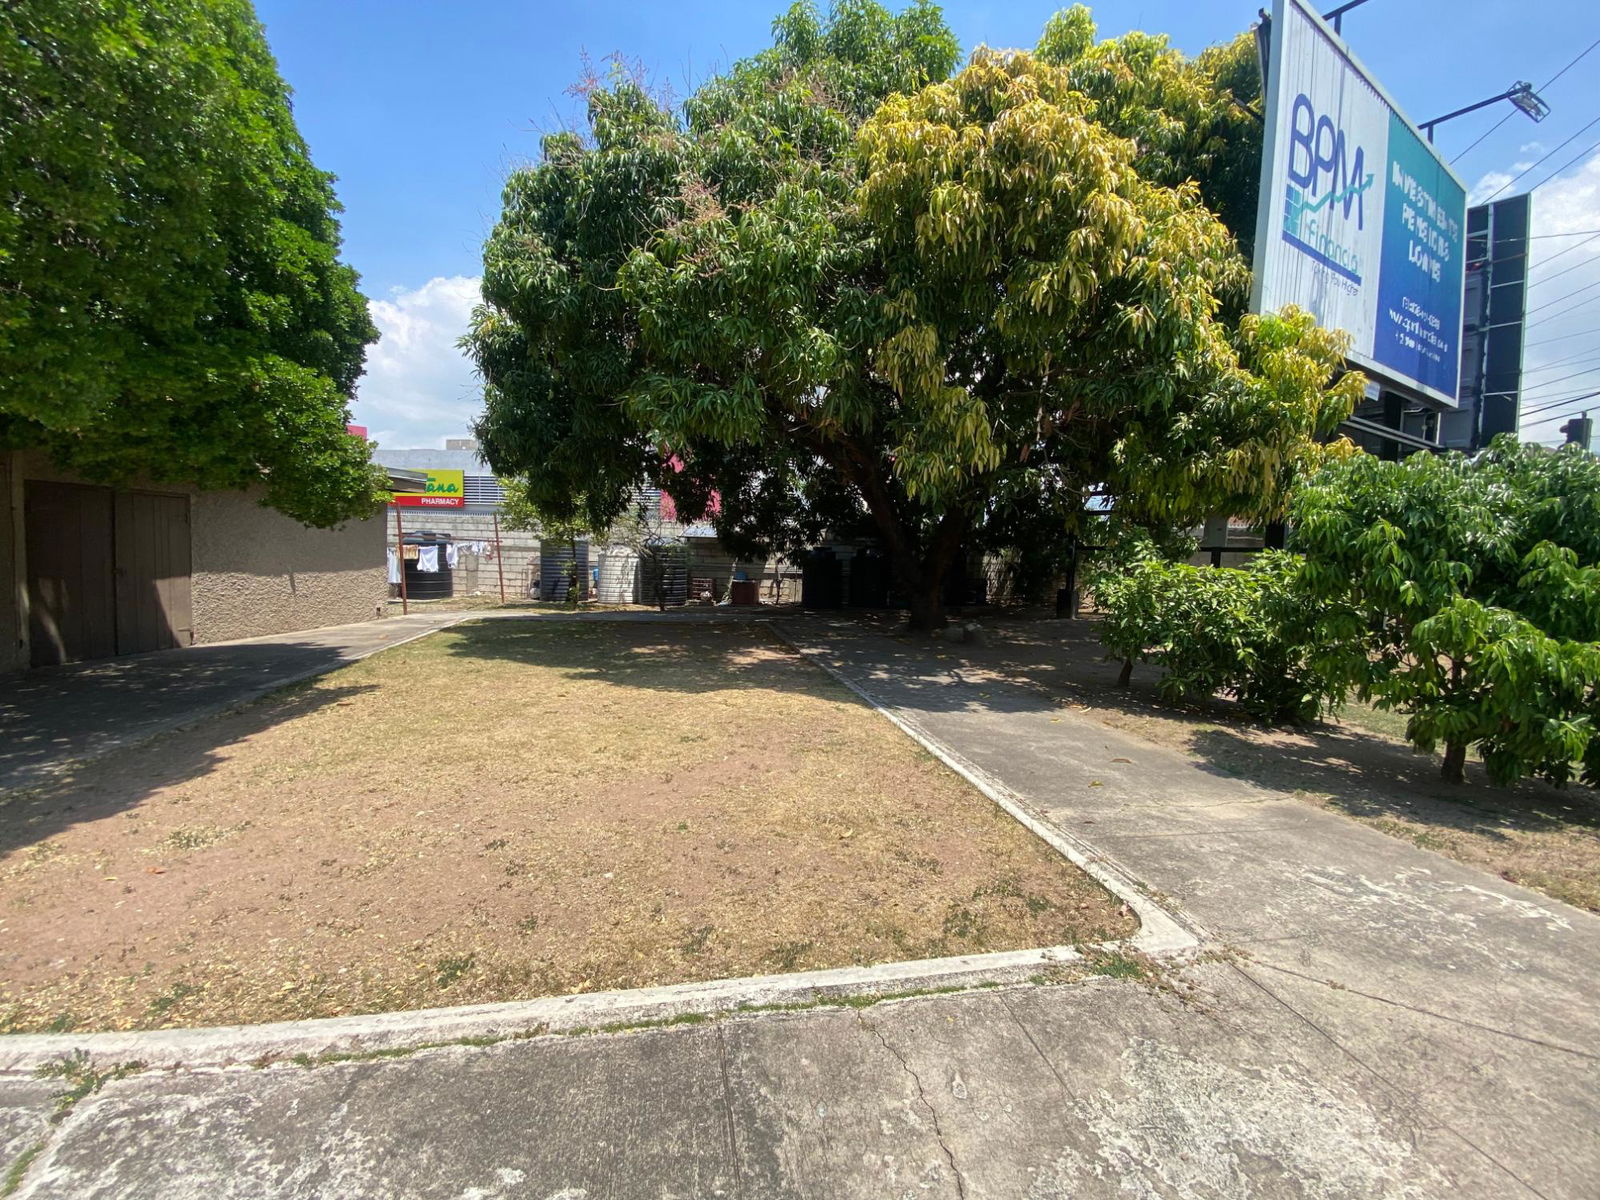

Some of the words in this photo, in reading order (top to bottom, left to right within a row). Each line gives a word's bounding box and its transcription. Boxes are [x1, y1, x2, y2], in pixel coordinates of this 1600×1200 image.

[1288, 93, 1363, 231] BPM
[1408, 239, 1441, 283] LOANS
[421, 497, 459, 505] PHARMACY
